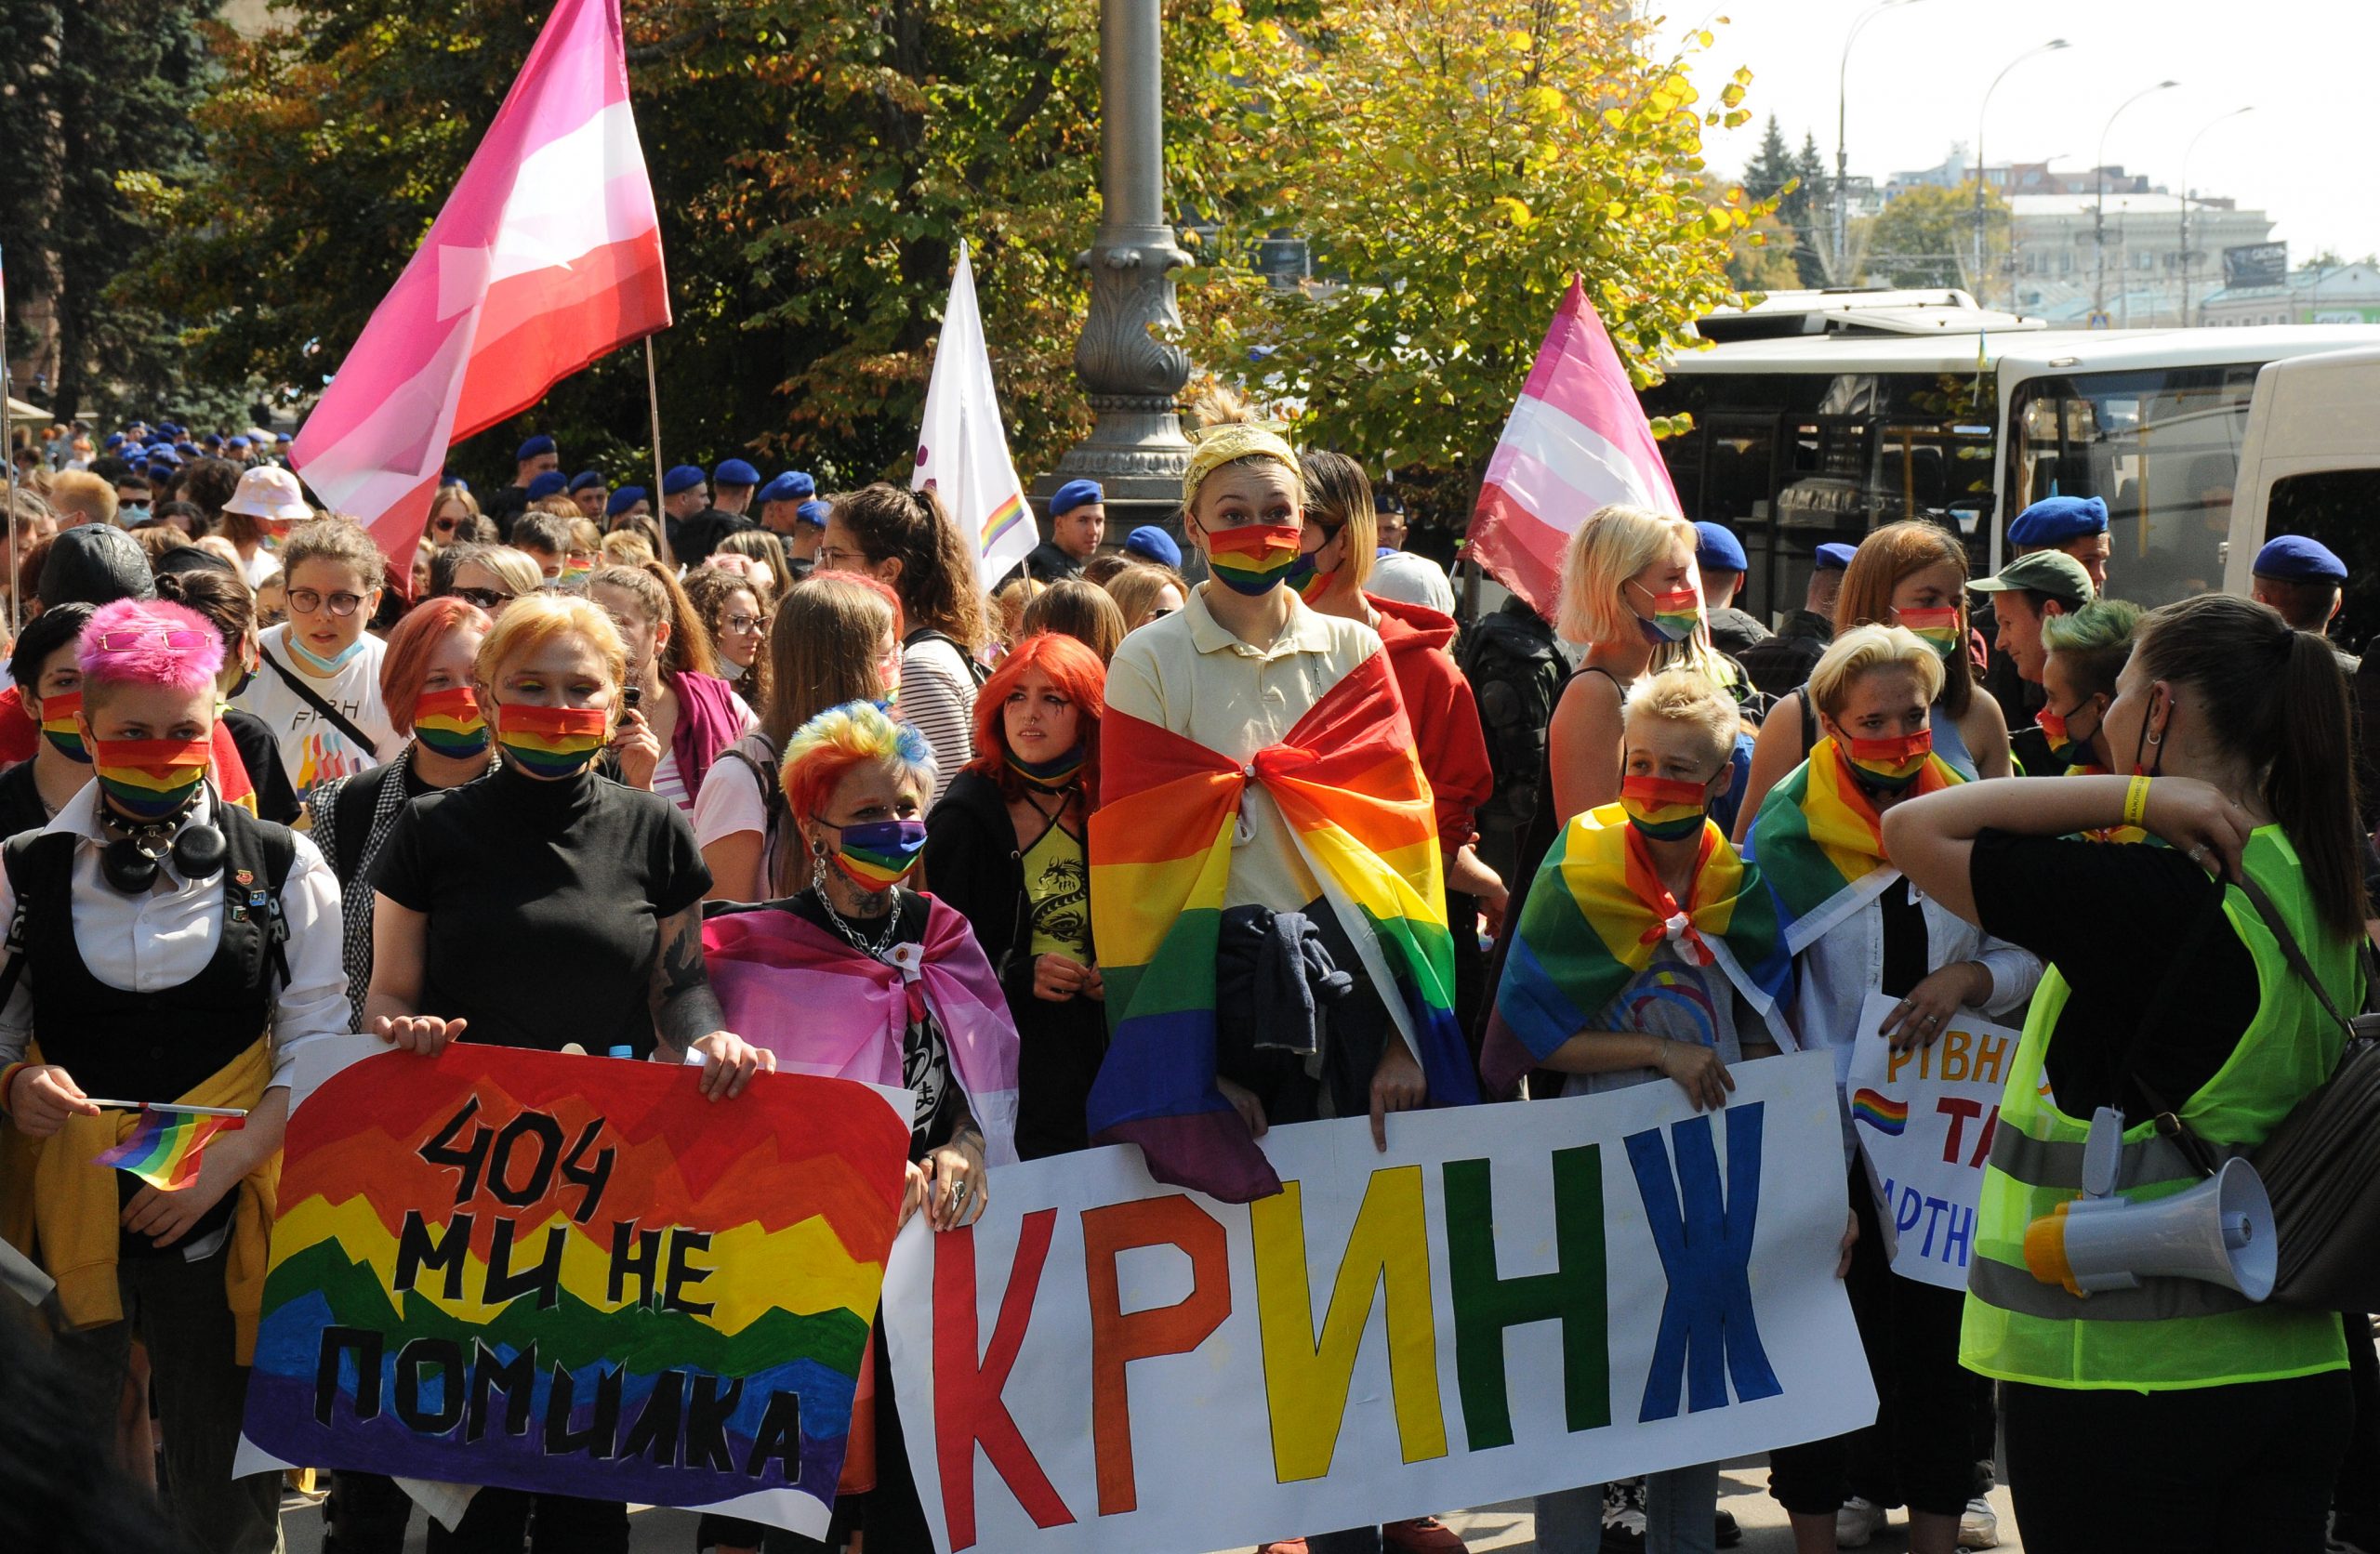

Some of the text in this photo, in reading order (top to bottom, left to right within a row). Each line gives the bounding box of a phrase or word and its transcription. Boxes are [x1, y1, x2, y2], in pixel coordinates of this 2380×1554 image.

[1887, 1031, 2051, 1095] РІВН
[418, 1093, 618, 1224] 404
[393, 1209, 718, 1316] МИ НЕ
[932, 1100, 1785, 1553] КРИНЖ
[314, 1324, 803, 1484] ПОМИЛКА
